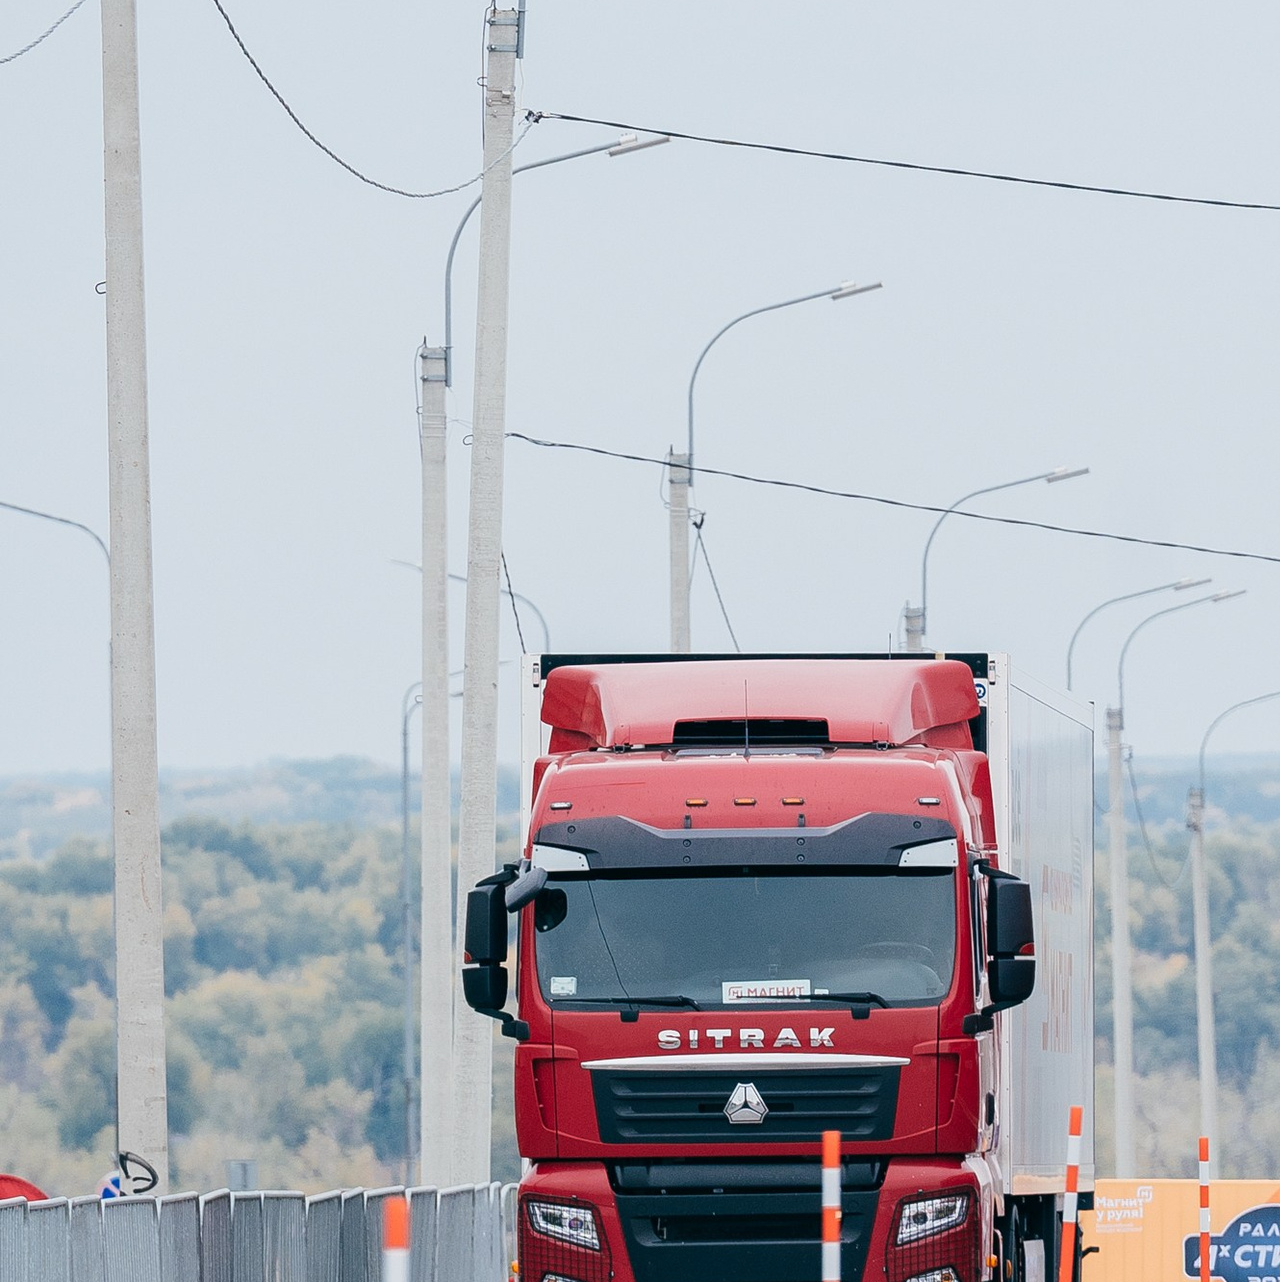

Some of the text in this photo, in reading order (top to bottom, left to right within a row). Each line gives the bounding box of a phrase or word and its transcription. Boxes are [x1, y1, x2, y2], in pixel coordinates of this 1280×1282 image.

[747, 986, 804, 998] МАГНИТ
[658, 1027, 836, 1049] SITRAK
[1096, 1197, 1143, 1209] Магнит
